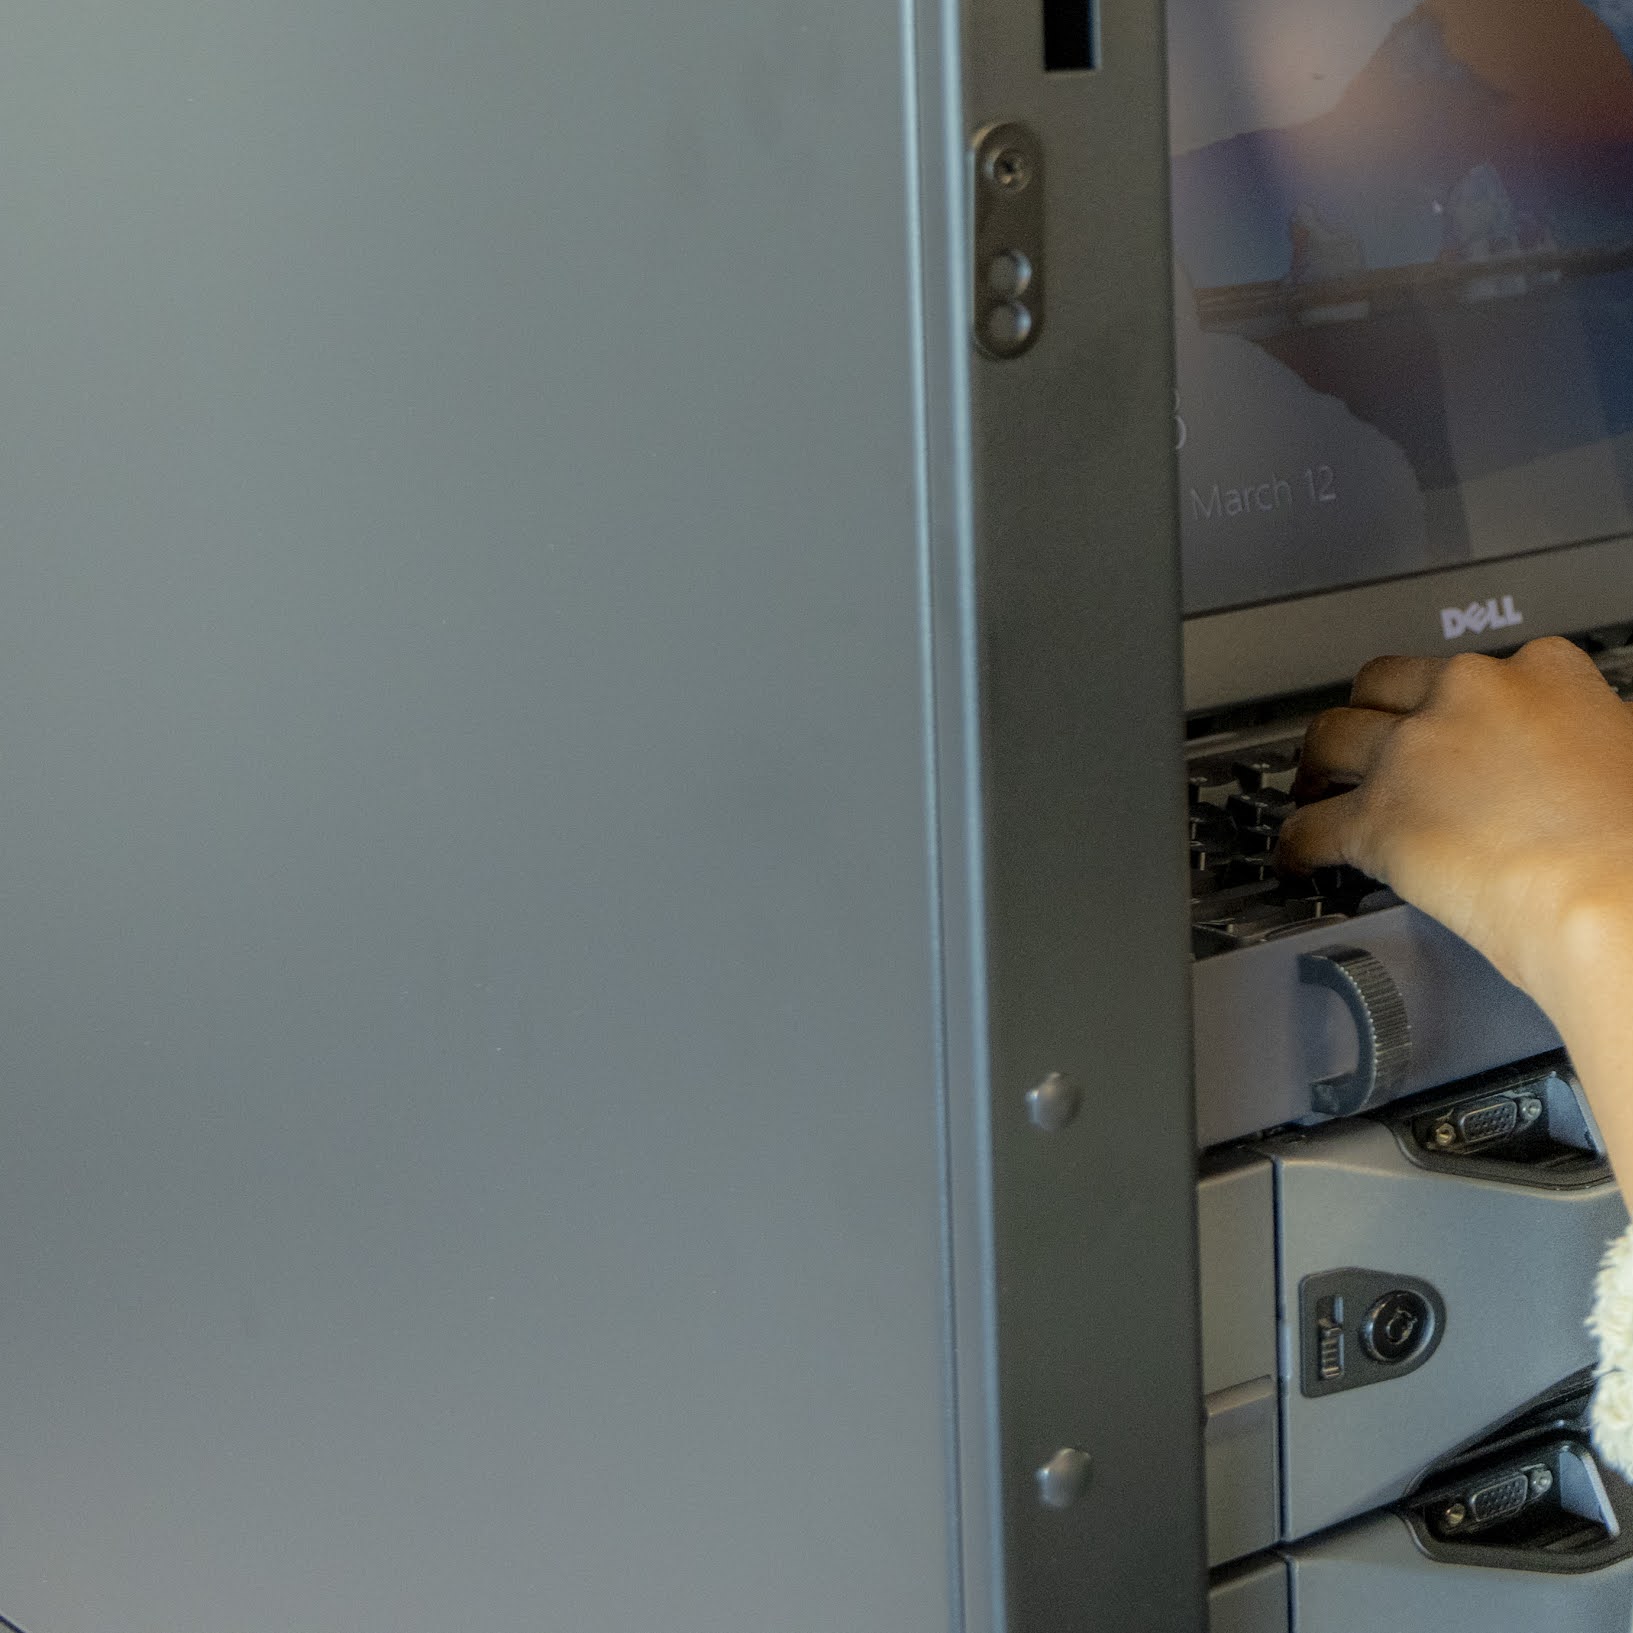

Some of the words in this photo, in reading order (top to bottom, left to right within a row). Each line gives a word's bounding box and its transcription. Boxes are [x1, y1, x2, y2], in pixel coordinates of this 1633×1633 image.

[1190, 473, 1294, 521] March
[1303, 464, 1337, 503] 12
[1441, 595, 1523, 640] DELL
